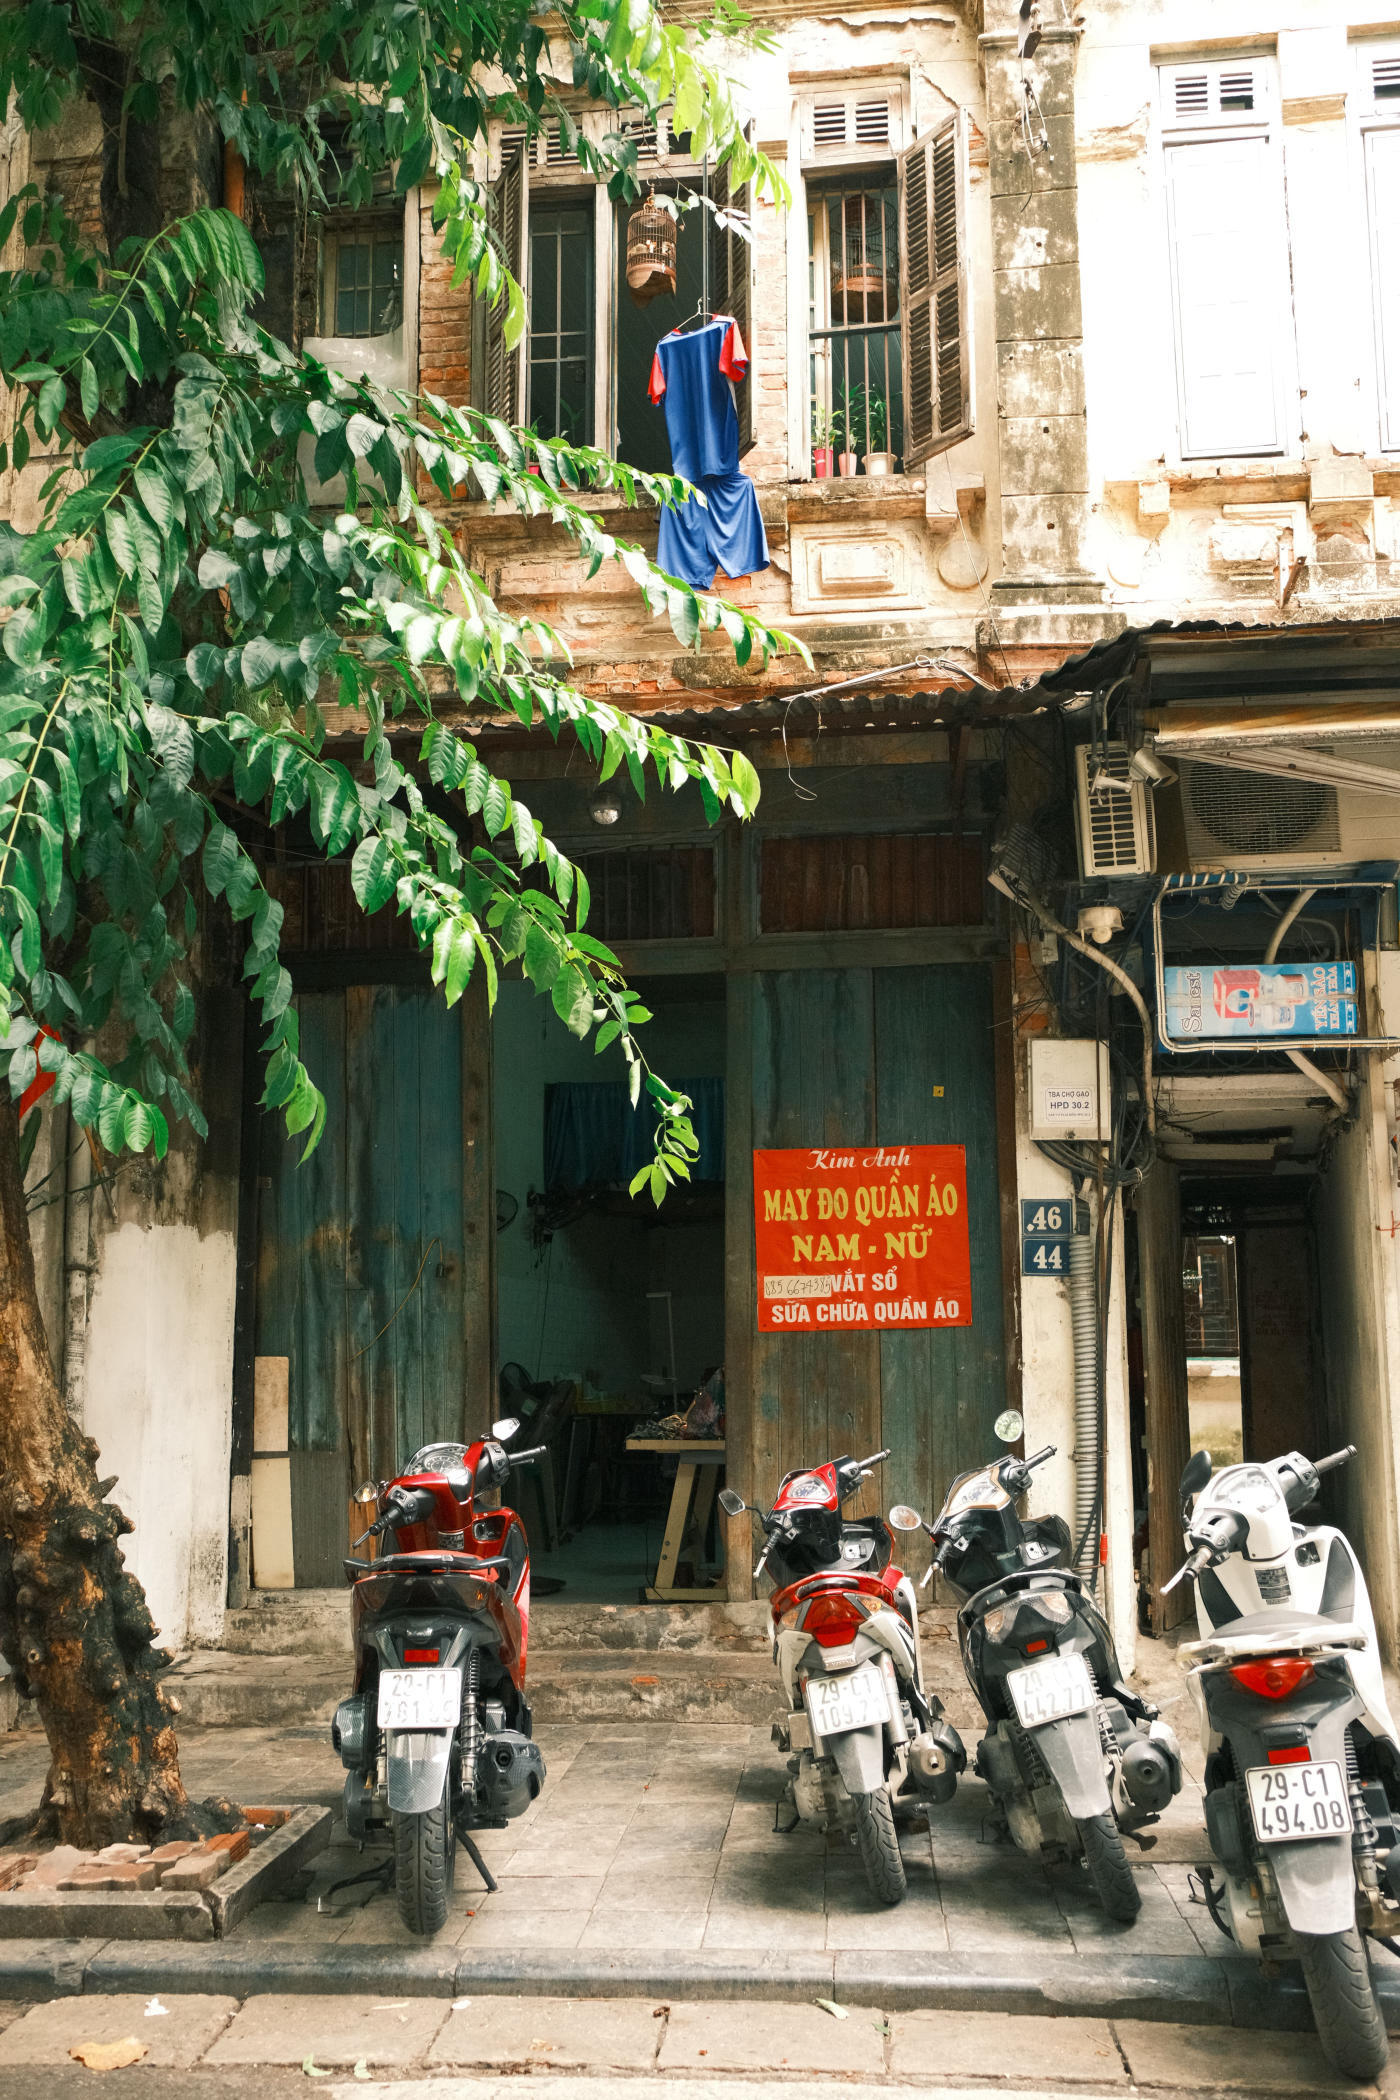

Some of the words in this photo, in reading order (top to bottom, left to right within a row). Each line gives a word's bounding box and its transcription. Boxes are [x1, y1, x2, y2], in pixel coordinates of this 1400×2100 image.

[1050, 1101, 1070, 1110] HPD
[1071, 1101, 1090, 1110] 30.2
[806, 1150, 857, 1170] Kim
[862, 1147, 912, 1168] Anh
[763, 1188, 812, 1222] MAY
[817, 1187, 849, 1220] ĐO
[854, 1168, 920, 1227] QUẦN
[925, 1173, 958, 1217] ÁO
[1033, 1206, 1062, 1231] 46
[791, 1233, 861, 1262] NAM
[884, 1223, 934, 1260] NỮ
[1033, 1245, 1062, 1270] 44
[830, 1268, 866, 1293] VẮT
[871, 1265, 898, 1292] SỔ
[816, 1298, 869, 1322] CHỮA
[874, 1295, 928, 1322] QUẦN
[933, 1297, 960, 1319] ÁO
[818, 1674, 873, 1705] 29-C1
[1023, 1684, 1086, 1722] 442.77
[1260, 1767, 1330, 1802] 29-C1
[1260, 1800, 1345, 1835] 494.08
